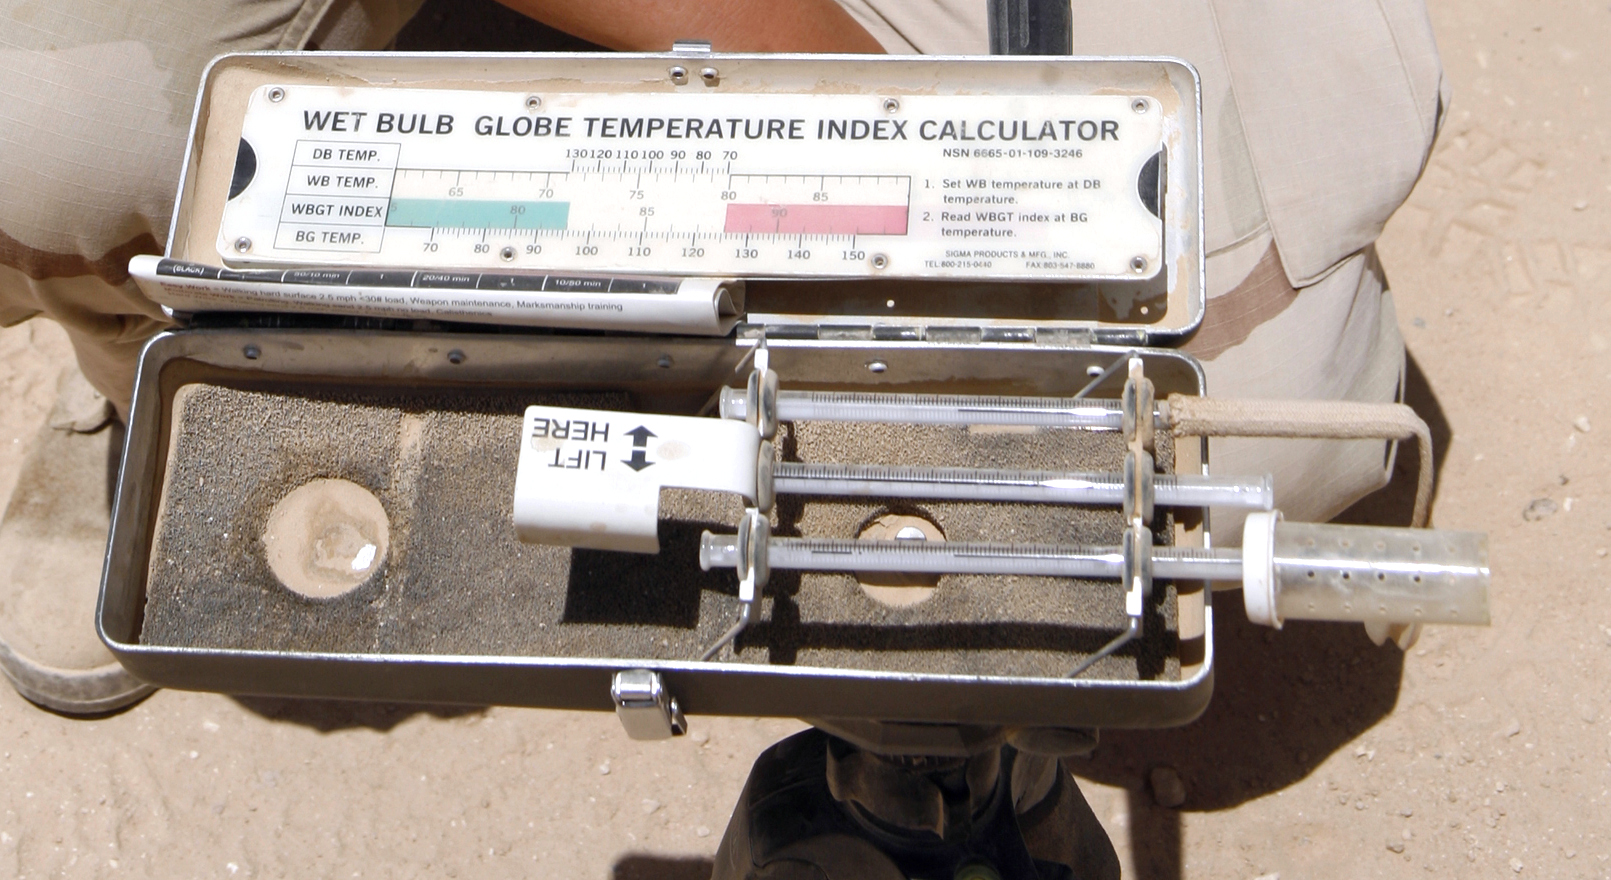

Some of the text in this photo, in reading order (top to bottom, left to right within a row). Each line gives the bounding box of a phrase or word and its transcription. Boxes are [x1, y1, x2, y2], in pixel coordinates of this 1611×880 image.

[303, 110, 1119, 141] WET BULB GLOBE TEMPERATURE INDEX CALCULATOR
[312, 148, 381, 162] DB TEMP.
[566, 149, 738, 161] 130 120 110 100 90 80 70
[943, 148, 1083, 159] NSN 6665-01-109-3246
[307, 174, 378, 189] WB TEMP.
[924, 179, 1101, 191] 1. Set WB temperature at DB
[448, 187, 829, 202] 65 70 75 80 85
[943, 194, 1019, 206] temperature.
[292, 203, 383, 218] WBGT INDEX
[510, 205, 526, 215] 80
[640, 207, 655, 217] 85
[771, 208, 788, 218] 90
[923, 212, 1088, 223] 2. Read WBGT index at BG
[295, 231, 364, 245] BG TEMP.
[941, 227, 1017, 239] temperature.
[423, 243, 865, 261] 70 80 90 100 110 120 130 140 150
[945, 250, 972, 258] SIGMA
[974, 250, 1018, 259] PRODUCTS
[173, 264, 205, 276] (BLACK)
[423, 274, 450, 282] 20/40
[221, 287, 258, 296] Walking
[284, 292, 317, 300] surface
[336, 295, 357, 303] mph
[410, 297, 449, 306] Weapon
[451, 299, 515, 309] maintenance,
[517, 301, 585, 311] Marksmanship
[588, 303, 623, 312] training
[532, 418, 610, 443] HERE
[548, 448, 607, 471] LIFT
